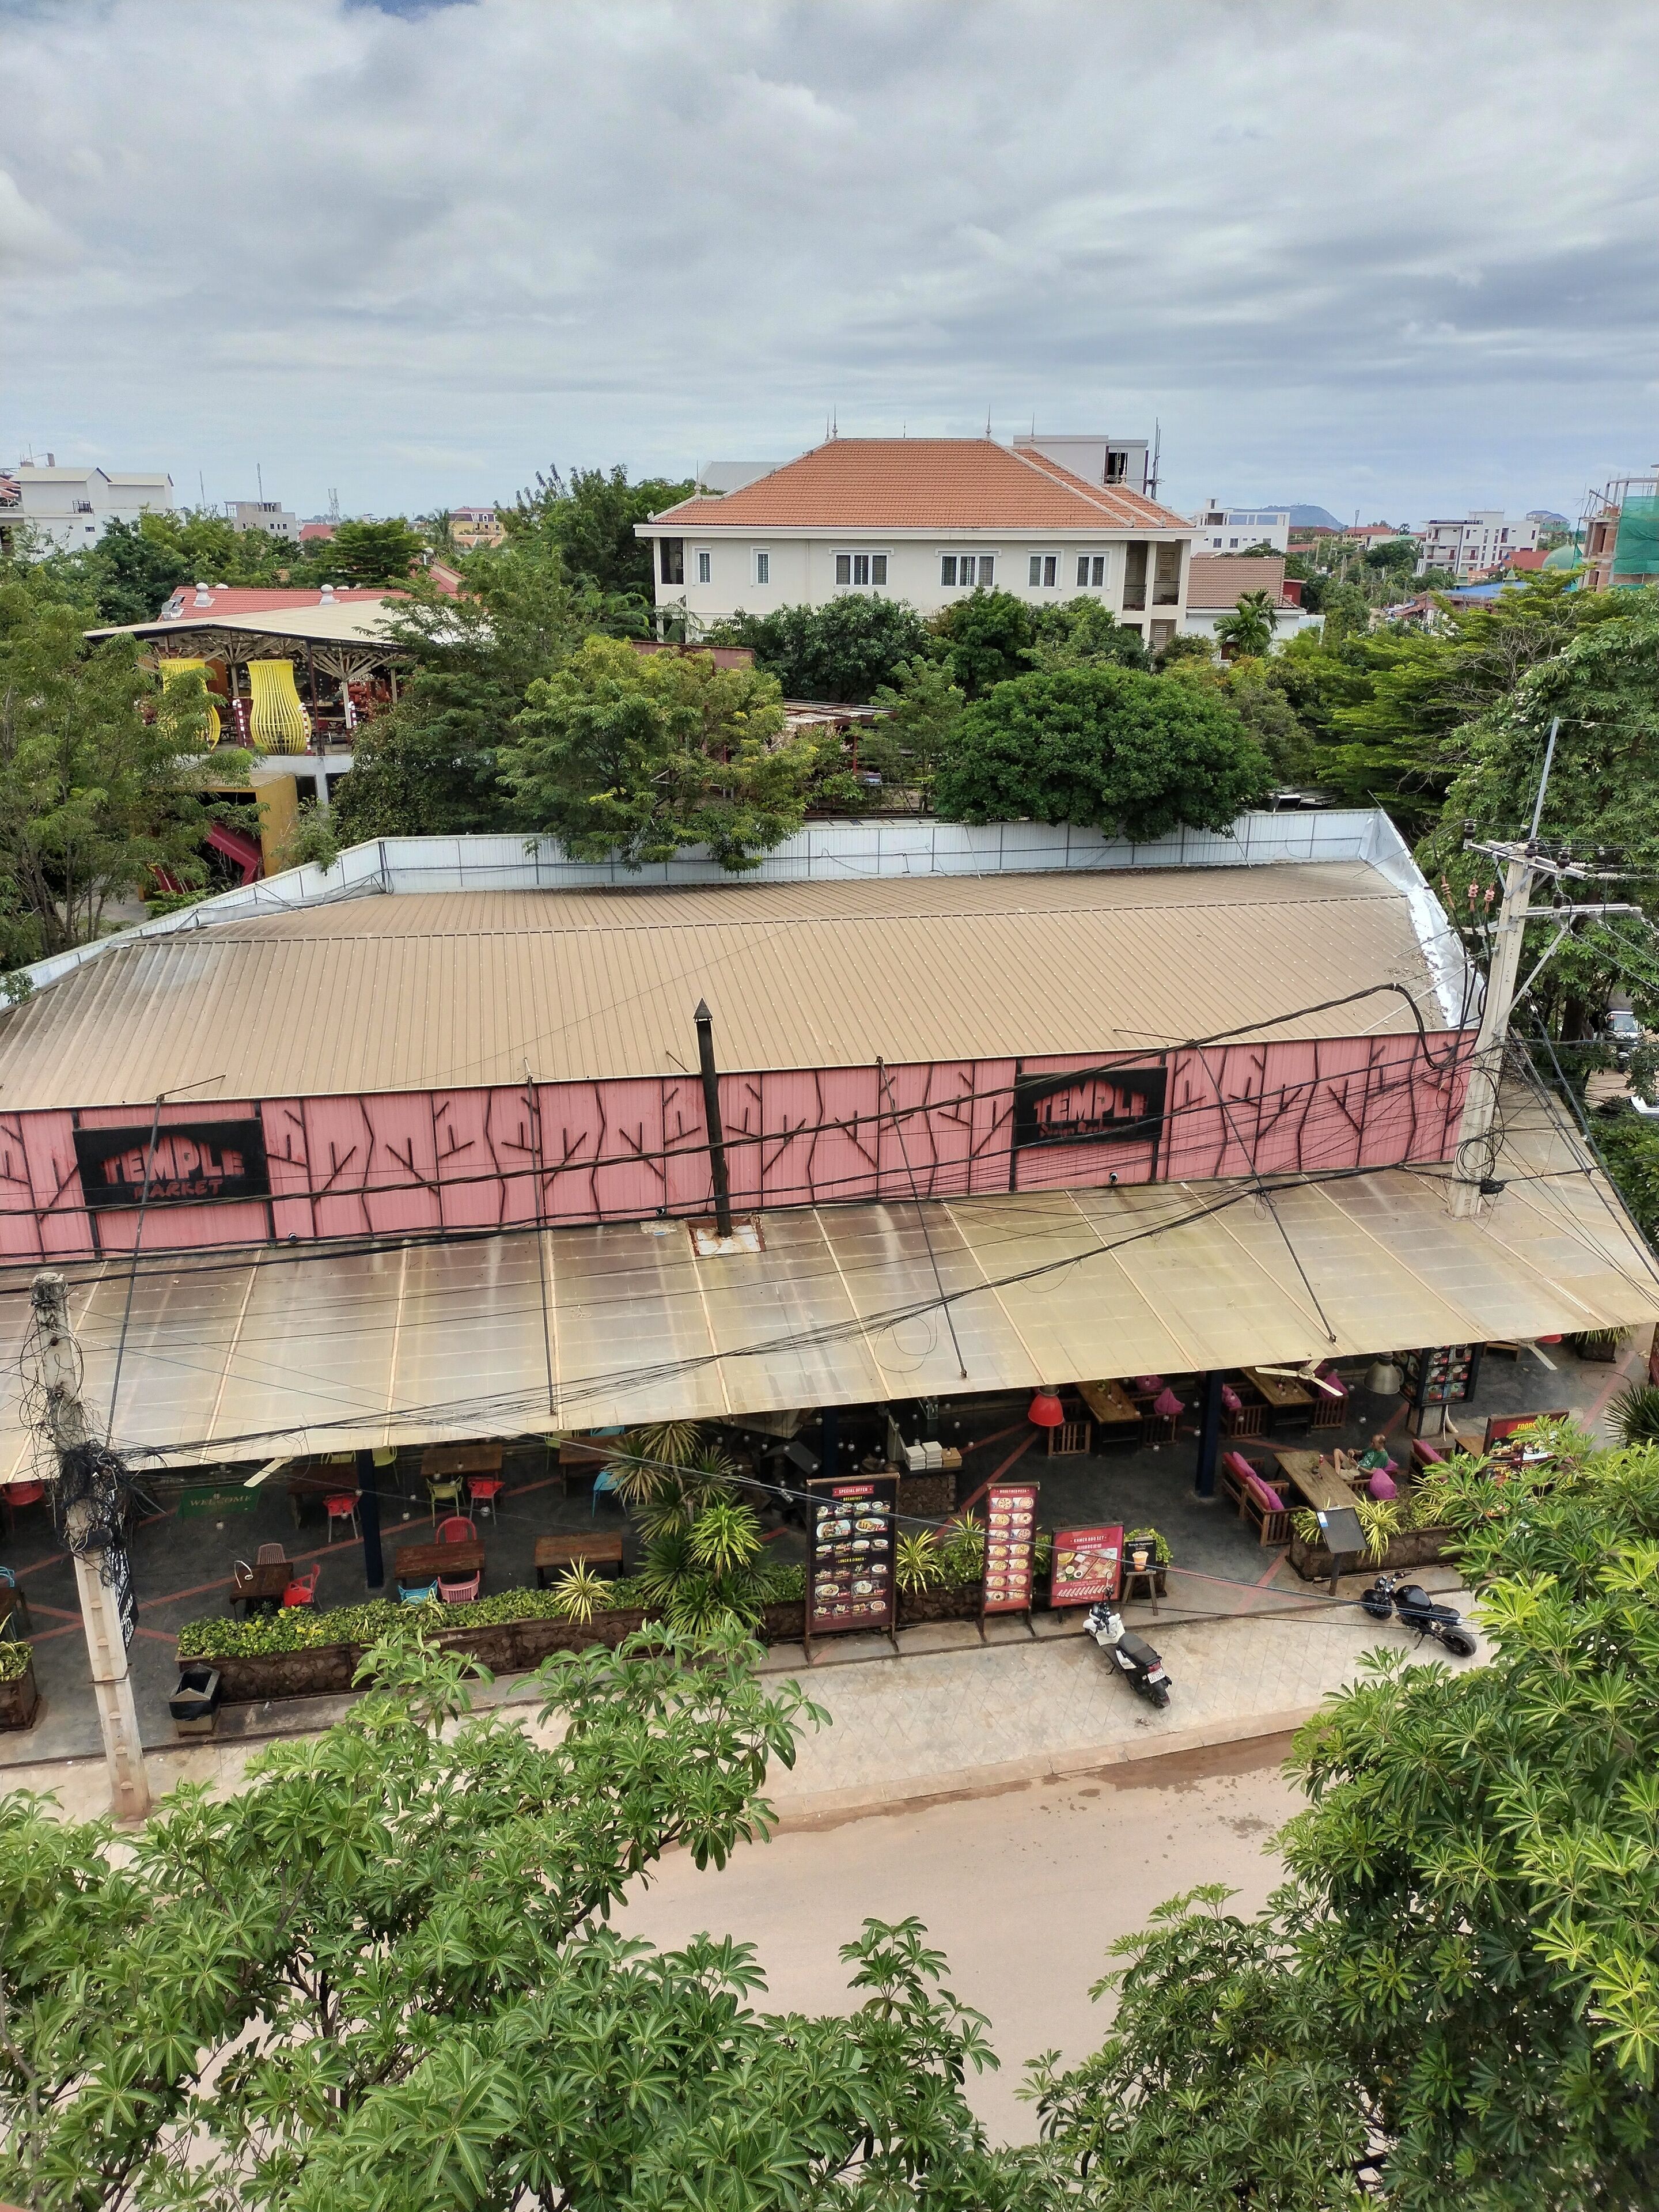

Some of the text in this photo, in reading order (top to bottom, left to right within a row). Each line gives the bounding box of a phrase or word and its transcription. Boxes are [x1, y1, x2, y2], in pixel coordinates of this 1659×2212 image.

[1033, 1079, 1147, 1123] TEMPLE
[101, 1134, 245, 1184] TEMPLE
[133, 1179, 223, 1200] MARKET
[190, 1495, 252, 1507] WELCOME
